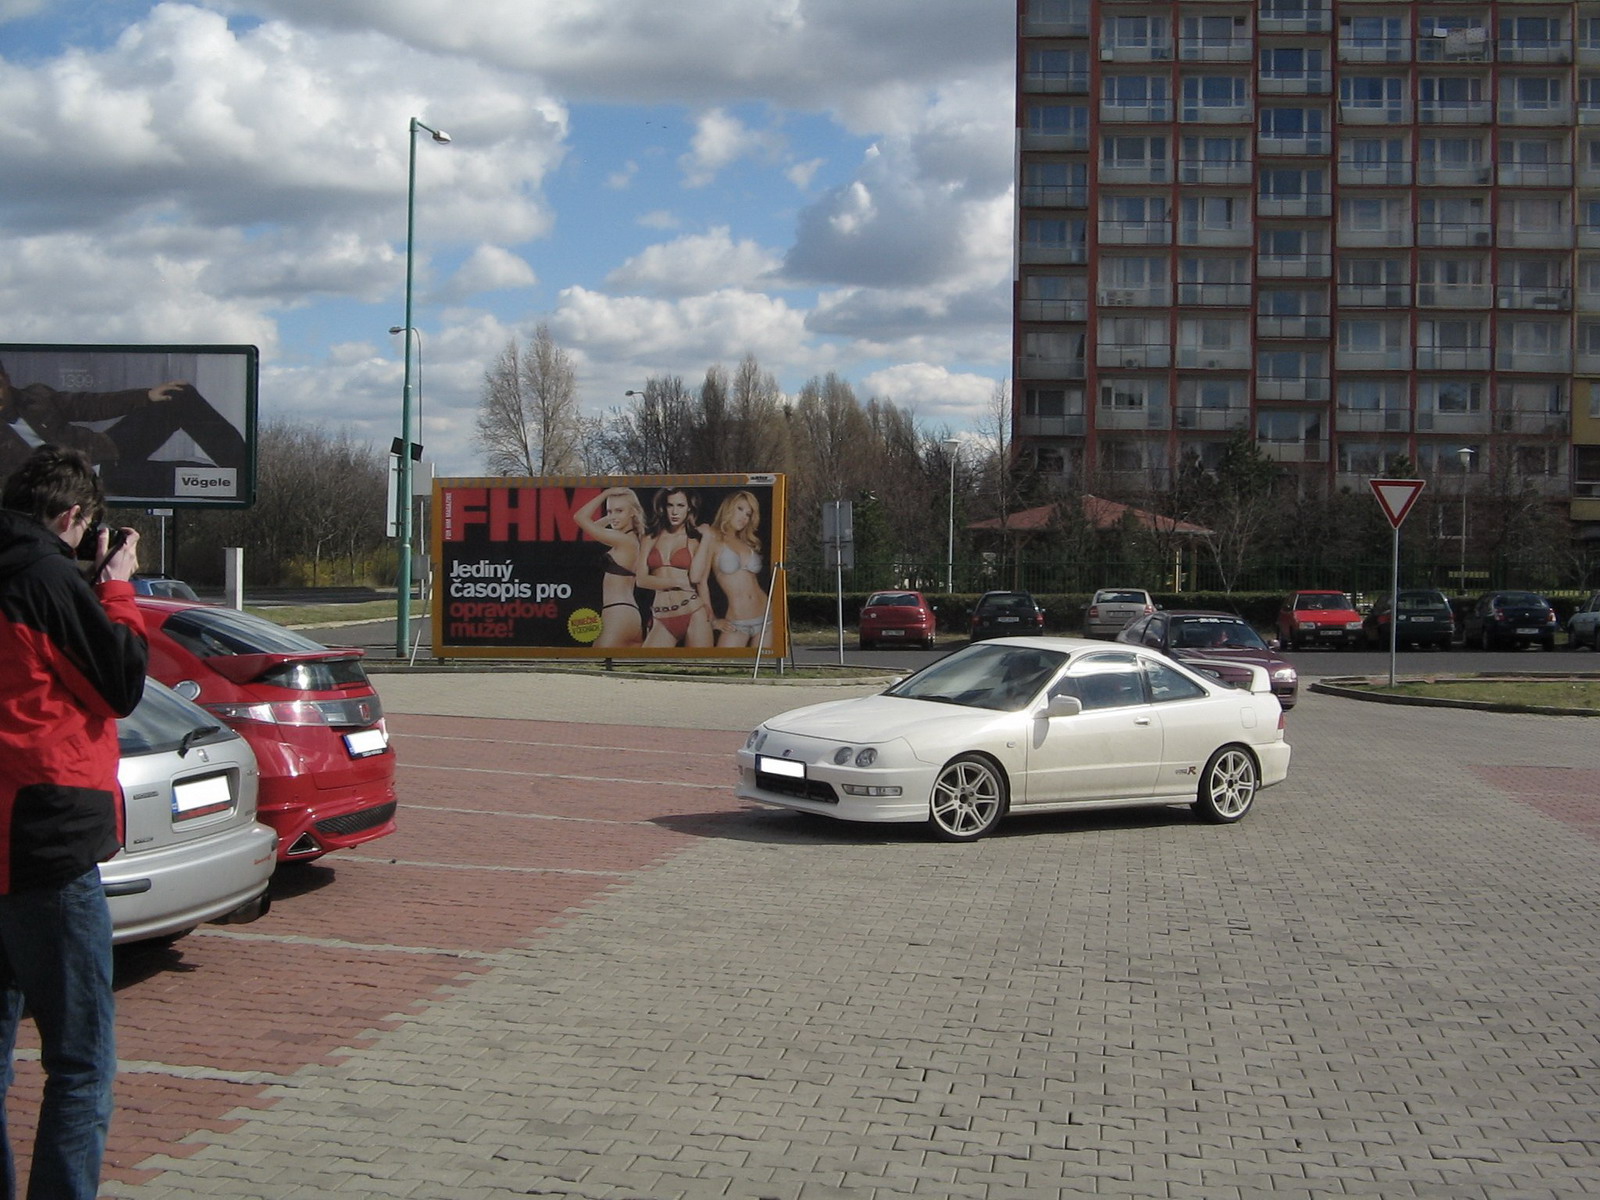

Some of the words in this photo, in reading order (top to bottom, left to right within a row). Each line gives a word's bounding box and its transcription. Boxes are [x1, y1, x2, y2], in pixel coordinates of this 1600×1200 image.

[181, 477, 231, 488] Vögele
[443, 487, 604, 542] FHM
[450, 559, 513, 582] Jediný
[450, 578, 532, 602] časopis
[536, 582, 572, 602] pro
[451, 599, 558, 621] opravdové
